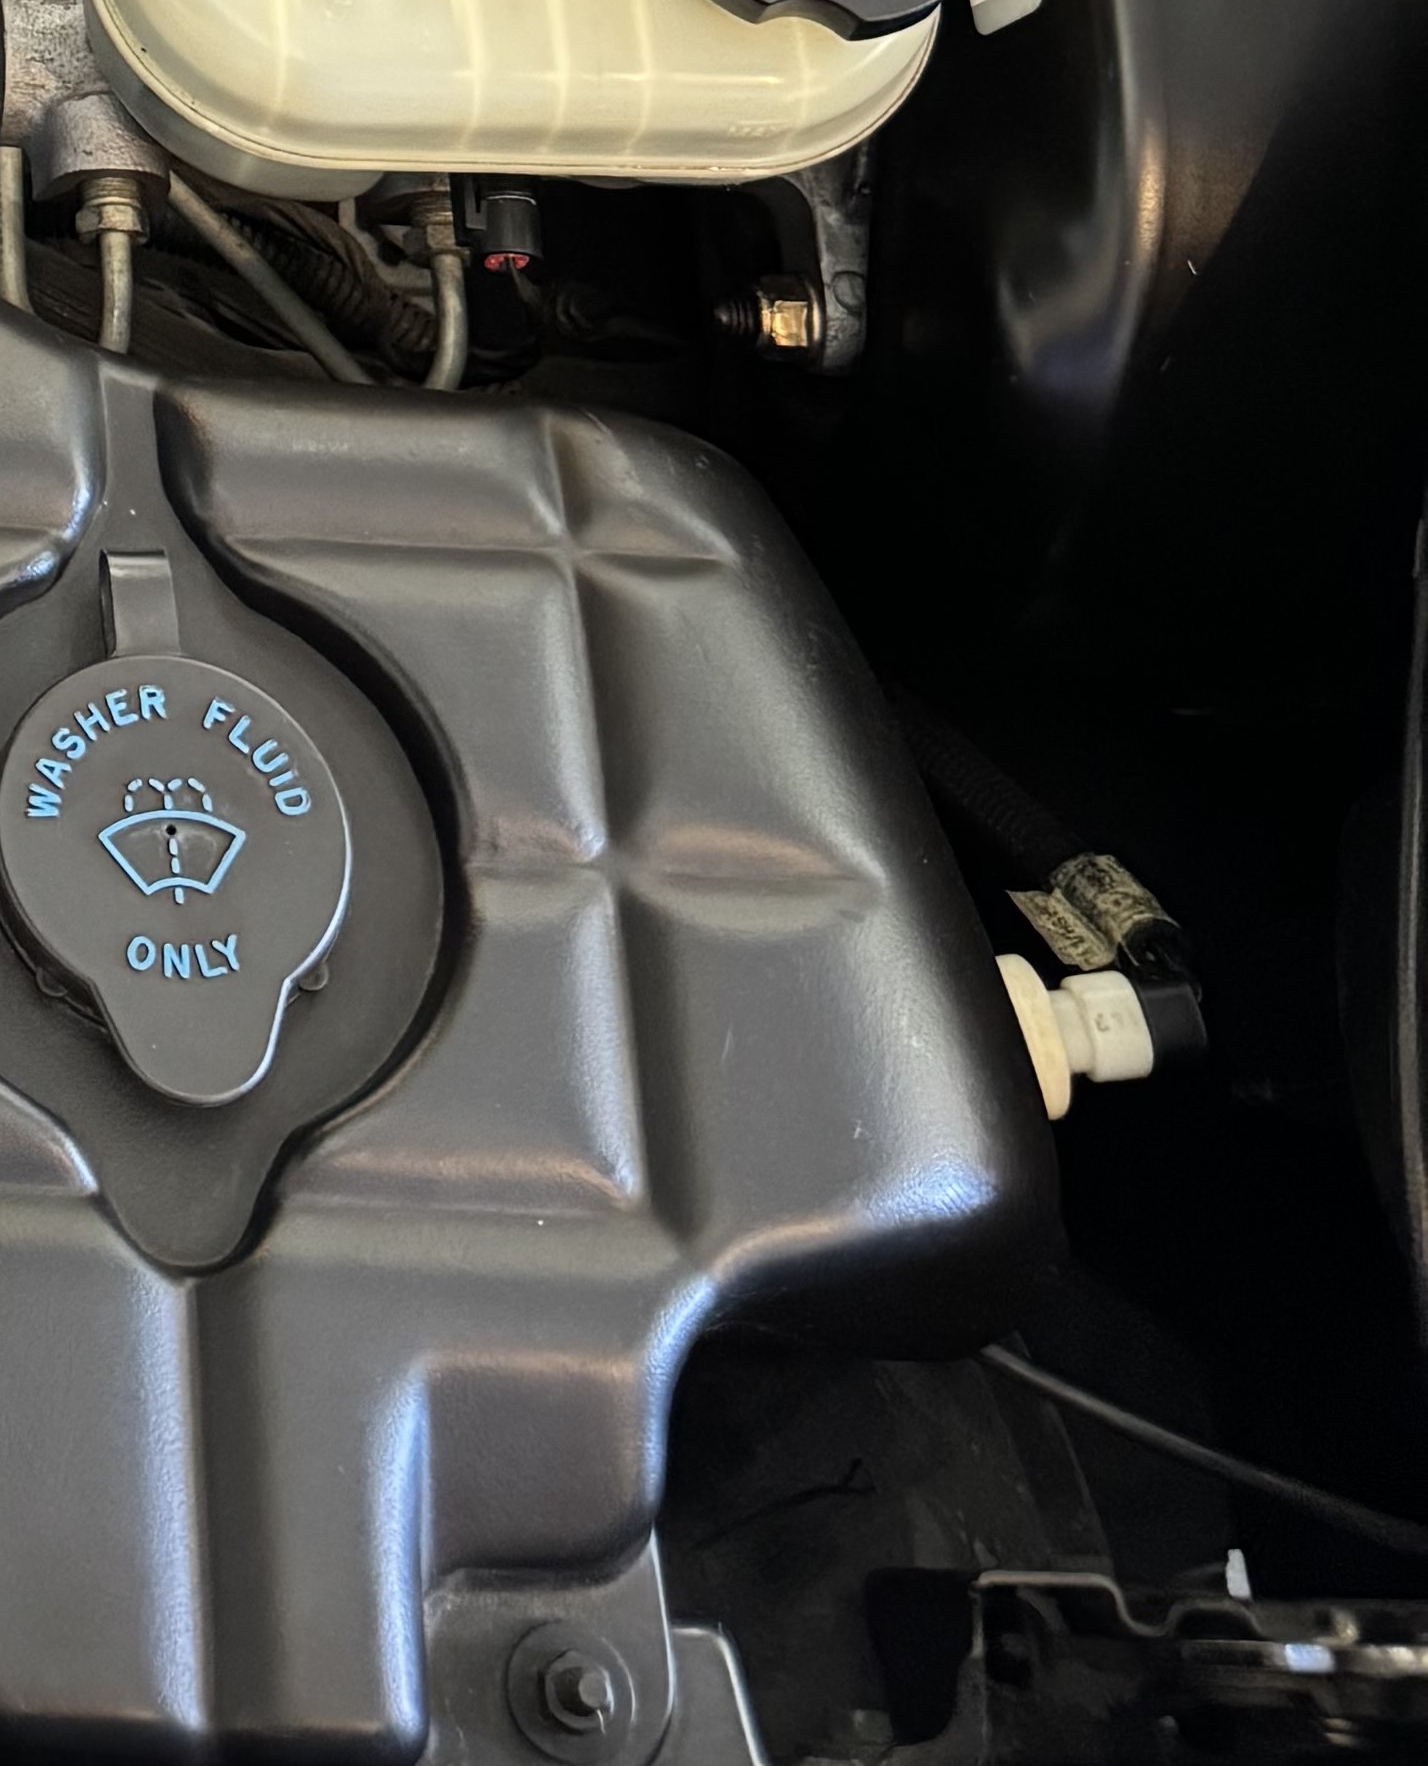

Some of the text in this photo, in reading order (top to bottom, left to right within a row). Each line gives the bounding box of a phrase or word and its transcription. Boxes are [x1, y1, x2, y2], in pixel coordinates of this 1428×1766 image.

[25, 684, 313, 819] WASHER FLUID
[126, 933, 241, 980] ONLY
